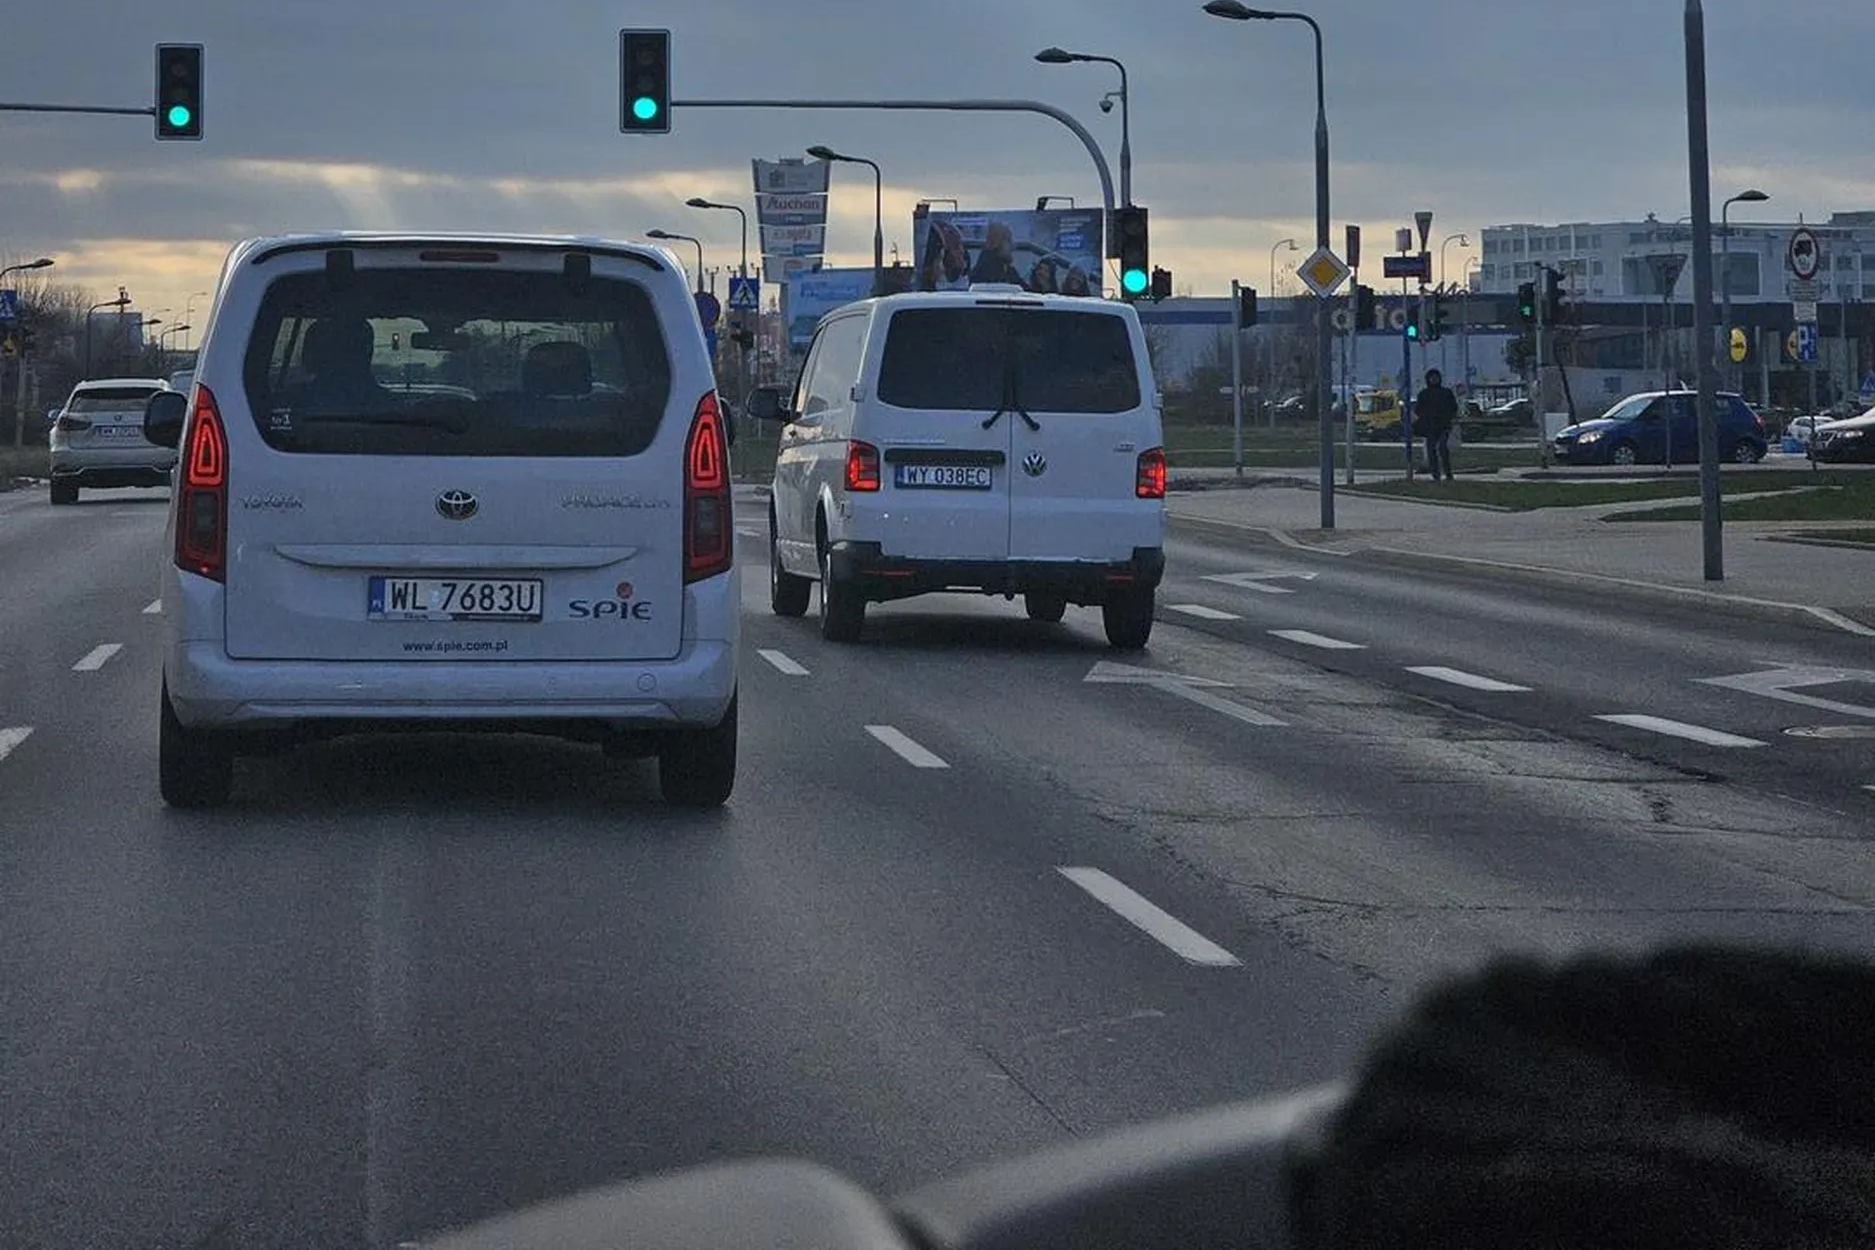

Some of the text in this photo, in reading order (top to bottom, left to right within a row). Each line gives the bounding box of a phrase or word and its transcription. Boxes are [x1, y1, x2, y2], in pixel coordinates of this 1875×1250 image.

[765, 196, 819, 210] Auchan
[907, 467, 986, 485] WY 038EC
[390, 581, 536, 612] WL 7683U
[568, 600, 652, 620] SPIE
[402, 639, 508, 653] www.spie.com.pl
